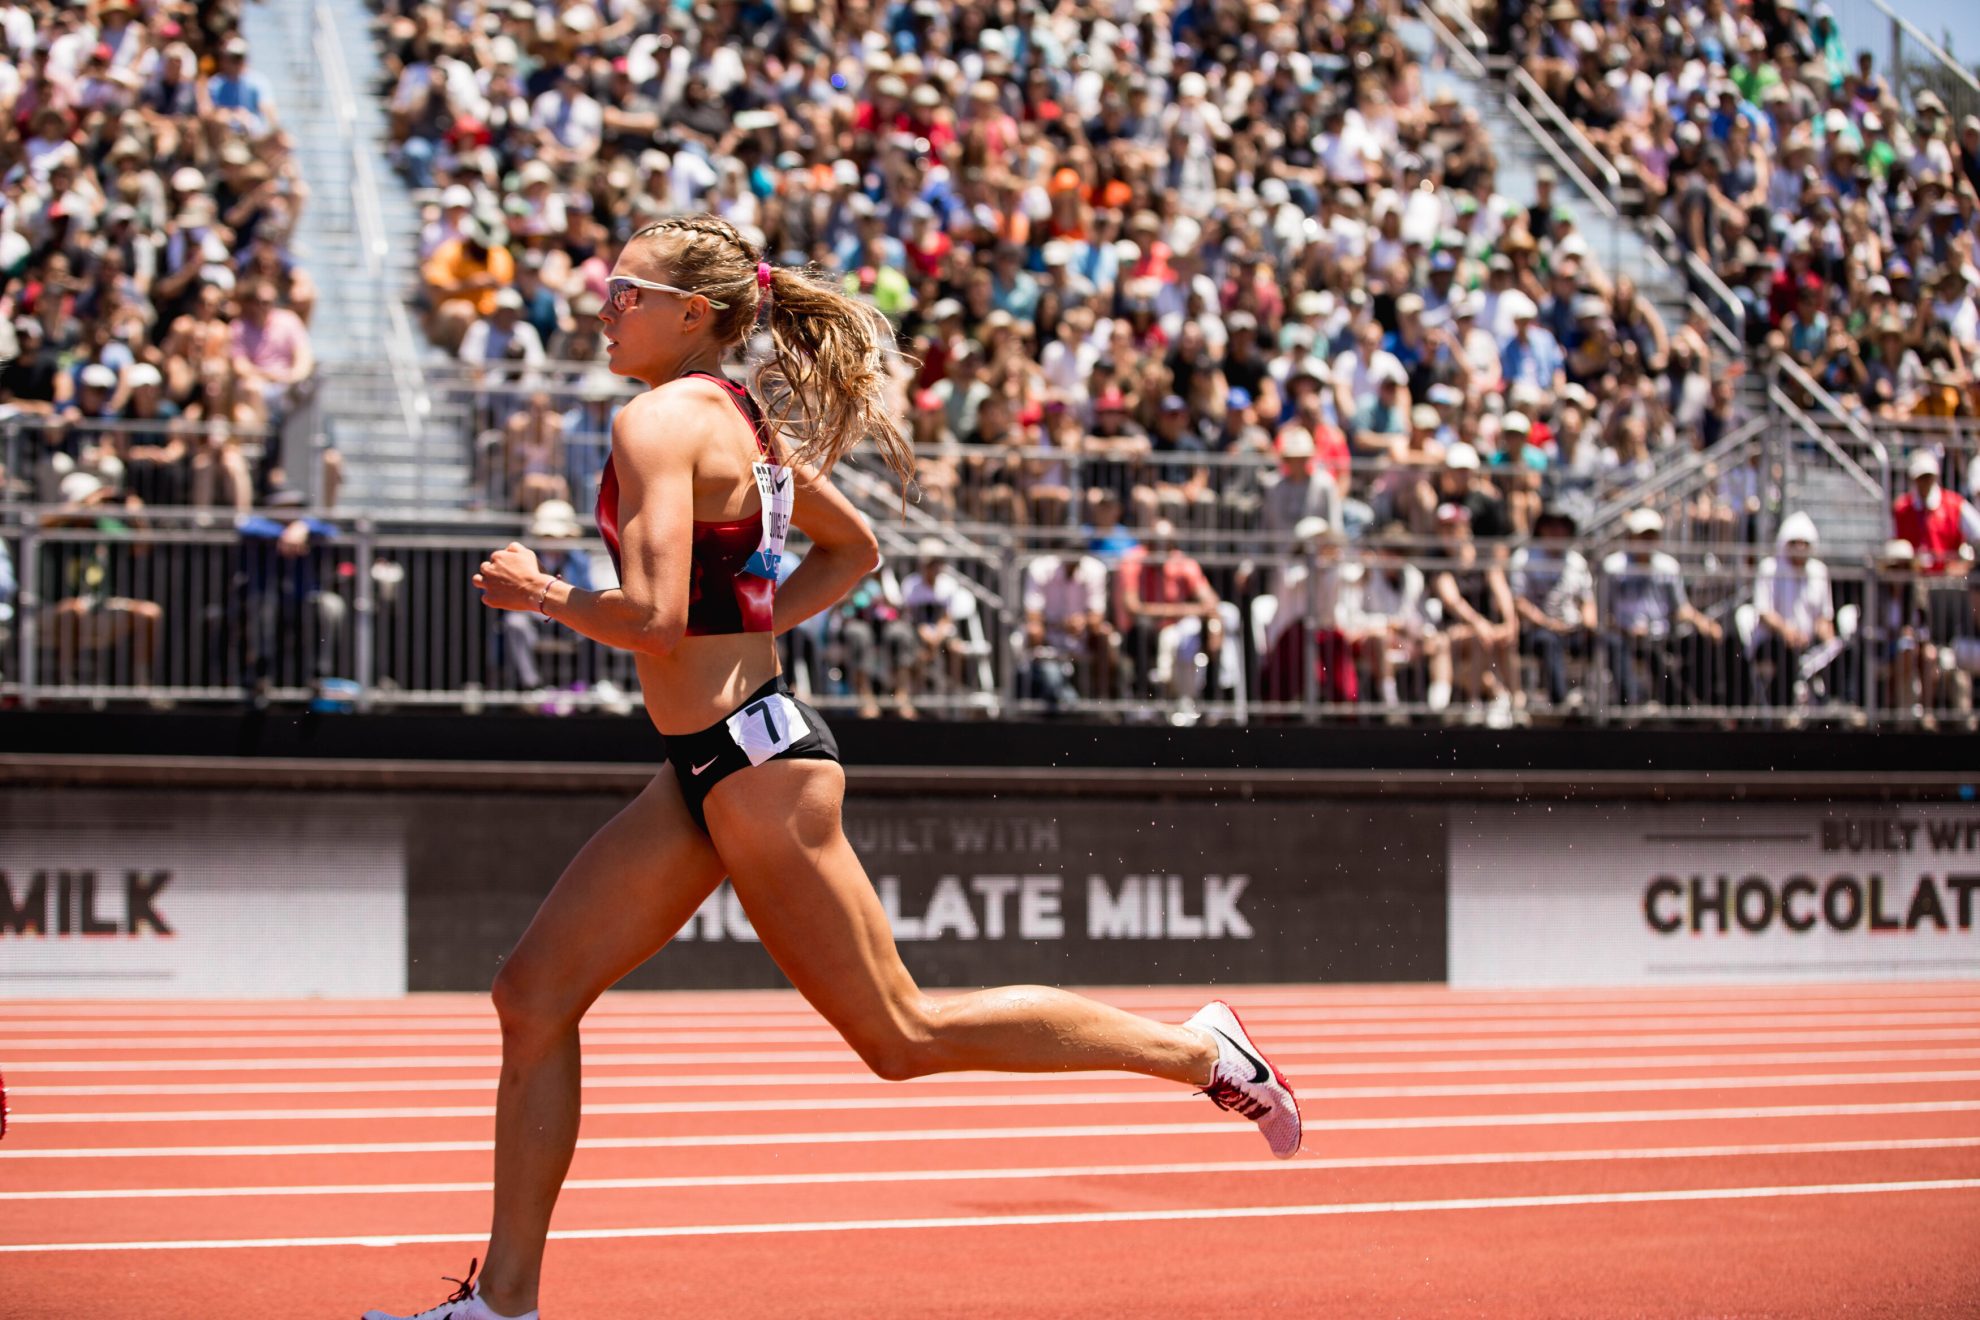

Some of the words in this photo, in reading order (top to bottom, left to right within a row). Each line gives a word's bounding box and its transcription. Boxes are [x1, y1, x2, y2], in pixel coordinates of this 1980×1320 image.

[744, 700, 781, 744] 7
[951, 818, 1060, 852] WITH
[1822, 817, 1919, 851] BUILT
[0, 870, 172, 935] MILK
[1086, 873, 1255, 939] MILK
[1643, 874, 1980, 932] CHOCOLAT
